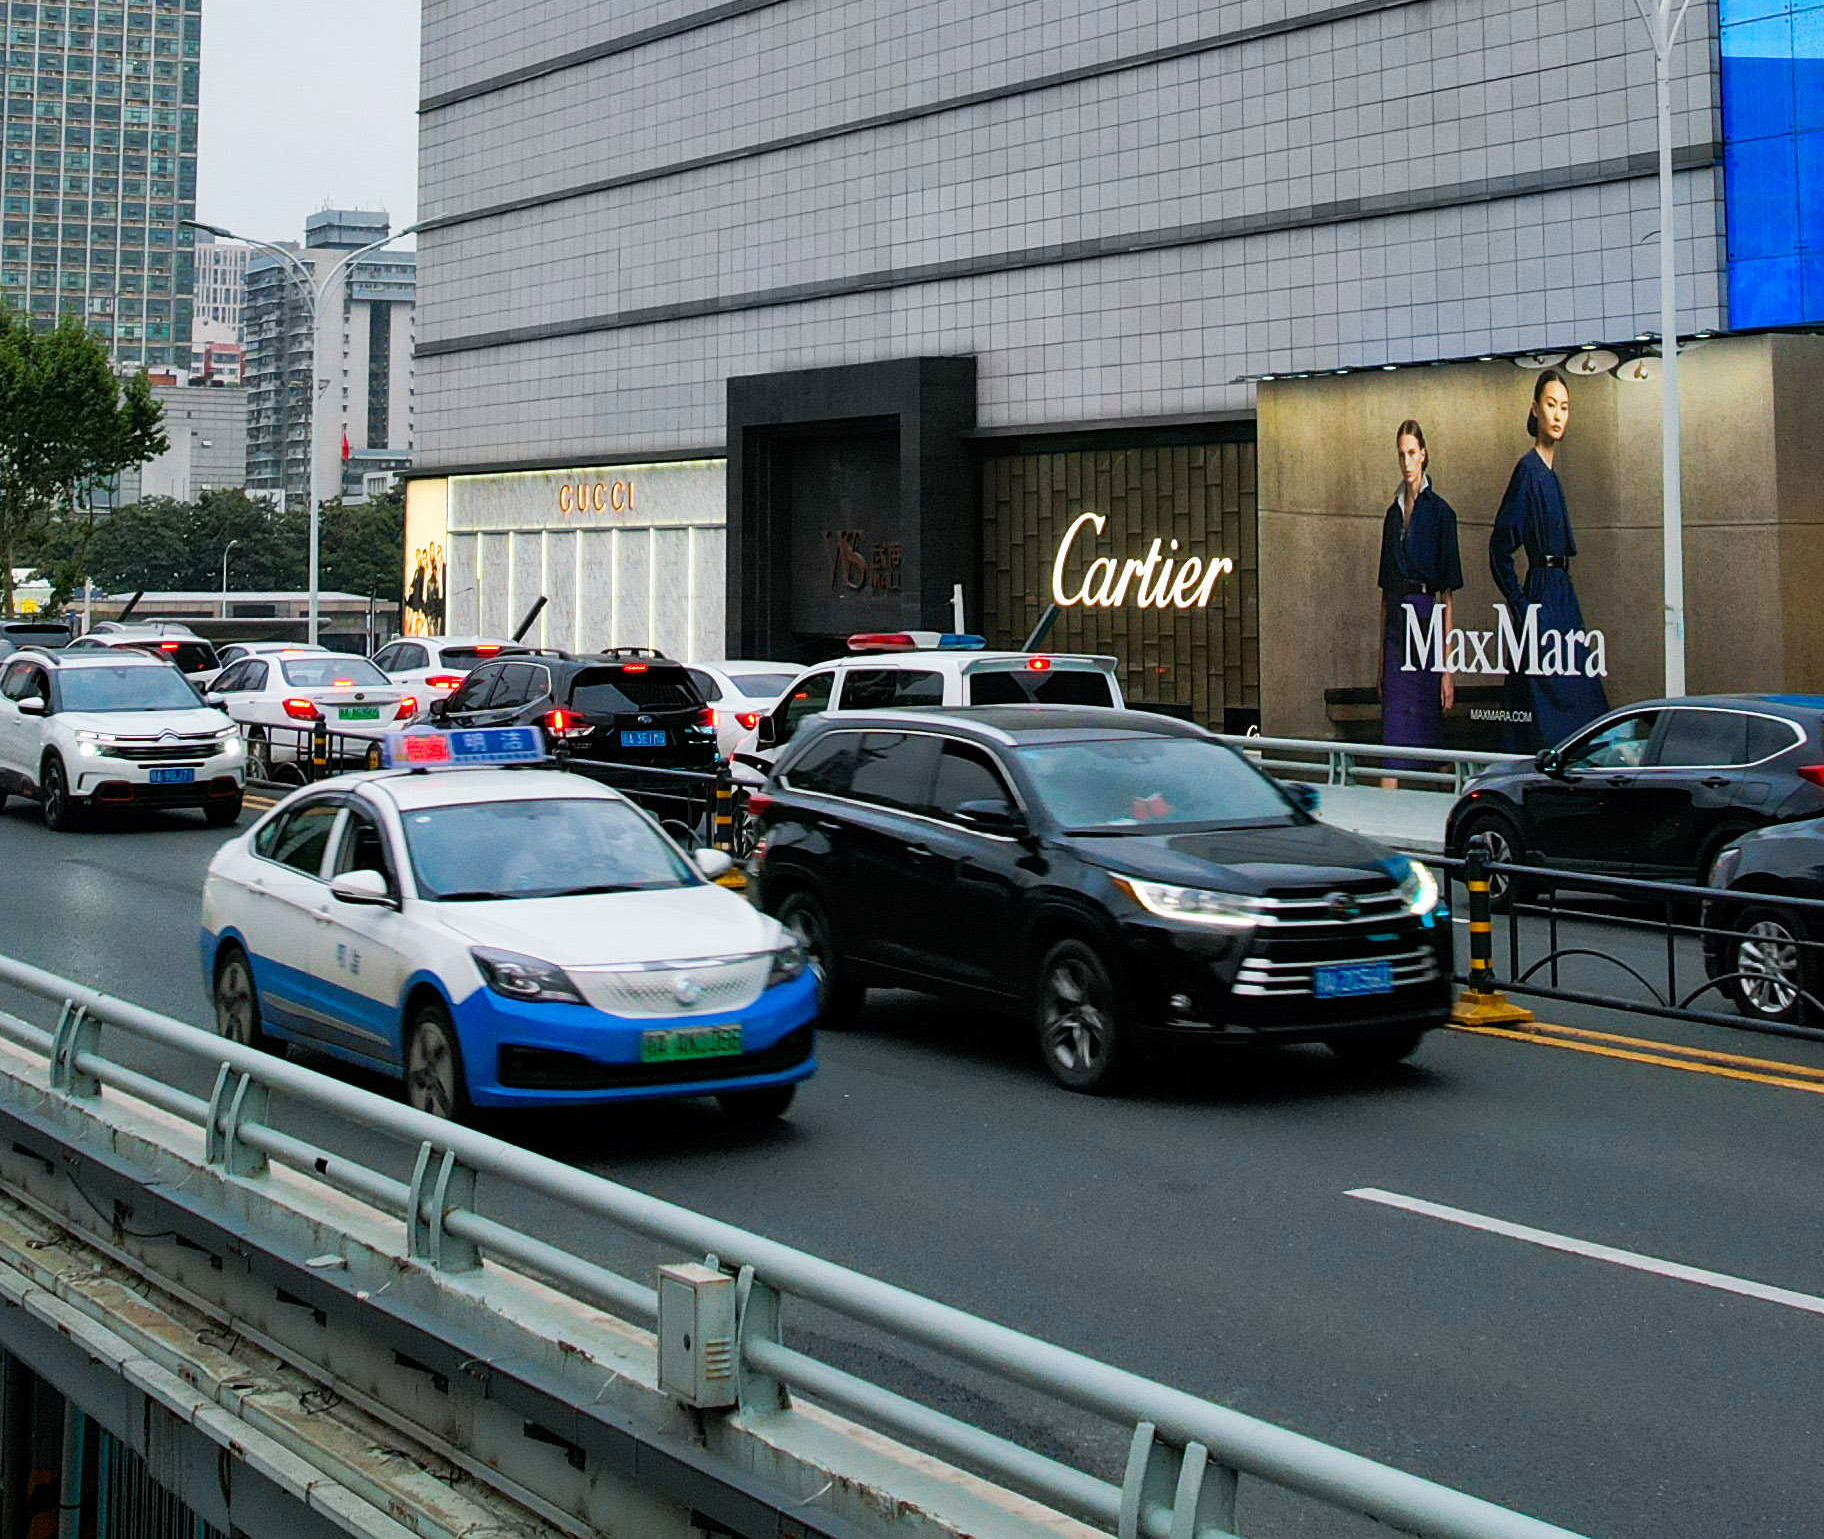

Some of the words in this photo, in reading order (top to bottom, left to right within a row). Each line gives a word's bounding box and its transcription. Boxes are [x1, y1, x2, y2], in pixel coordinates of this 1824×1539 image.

[559, 482, 636, 513] GUCCI
[1051, 511, 1232, 608] Cartier
[1401, 603, 1607, 678] MaxMara
[1470, 708, 1532, 722] MAXMARA.COM
